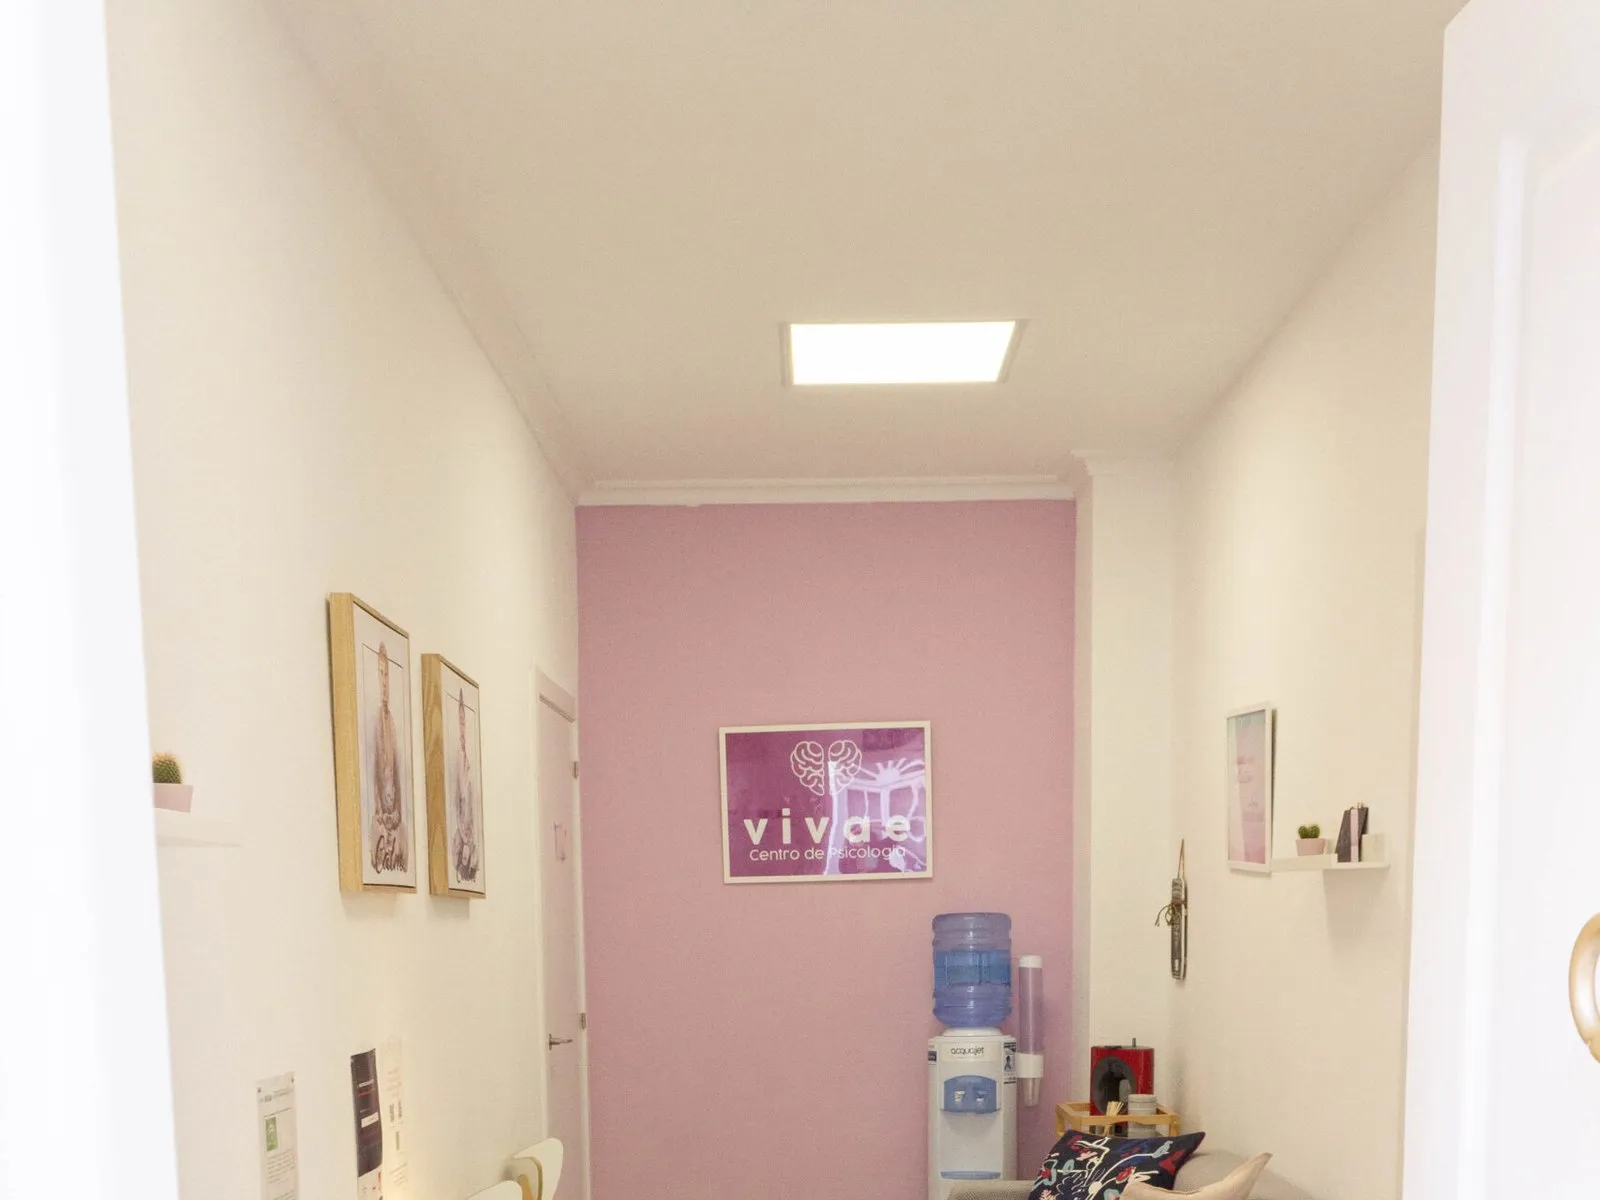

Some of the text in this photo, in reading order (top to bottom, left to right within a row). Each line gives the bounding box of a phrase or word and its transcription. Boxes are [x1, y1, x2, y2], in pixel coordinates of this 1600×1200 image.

[743, 807, 911, 845] vivae
[749, 847, 800, 861] Centro
[804, 846, 825, 860] de
